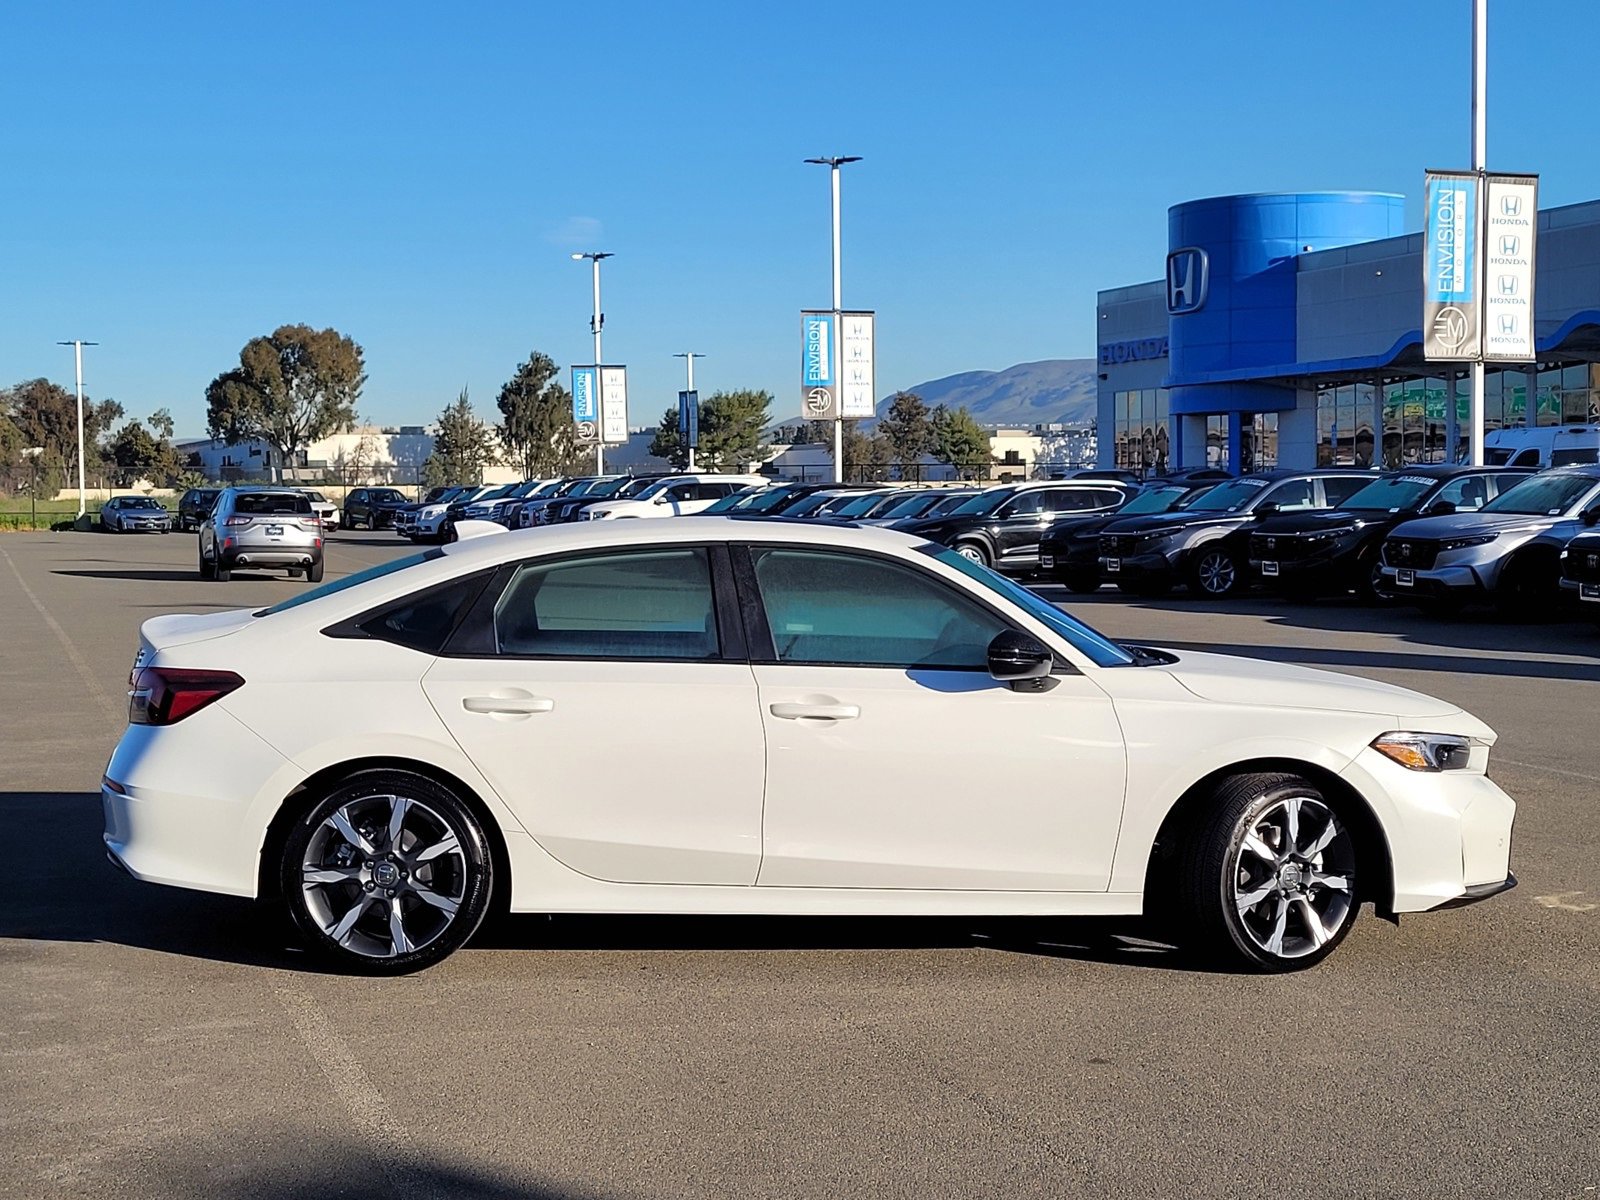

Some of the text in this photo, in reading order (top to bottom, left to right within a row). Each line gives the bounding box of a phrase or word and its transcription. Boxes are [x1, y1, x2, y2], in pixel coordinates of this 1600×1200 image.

[1491, 217, 1529, 226] HONDA
[1438, 189, 1453, 292] ENVISION
[1490, 257, 1528, 266] HONDA
[1489, 297, 1527, 305] HONDA
[1490, 336, 1526, 345] HONDA
[809, 320, 819, 380] ENVISION
